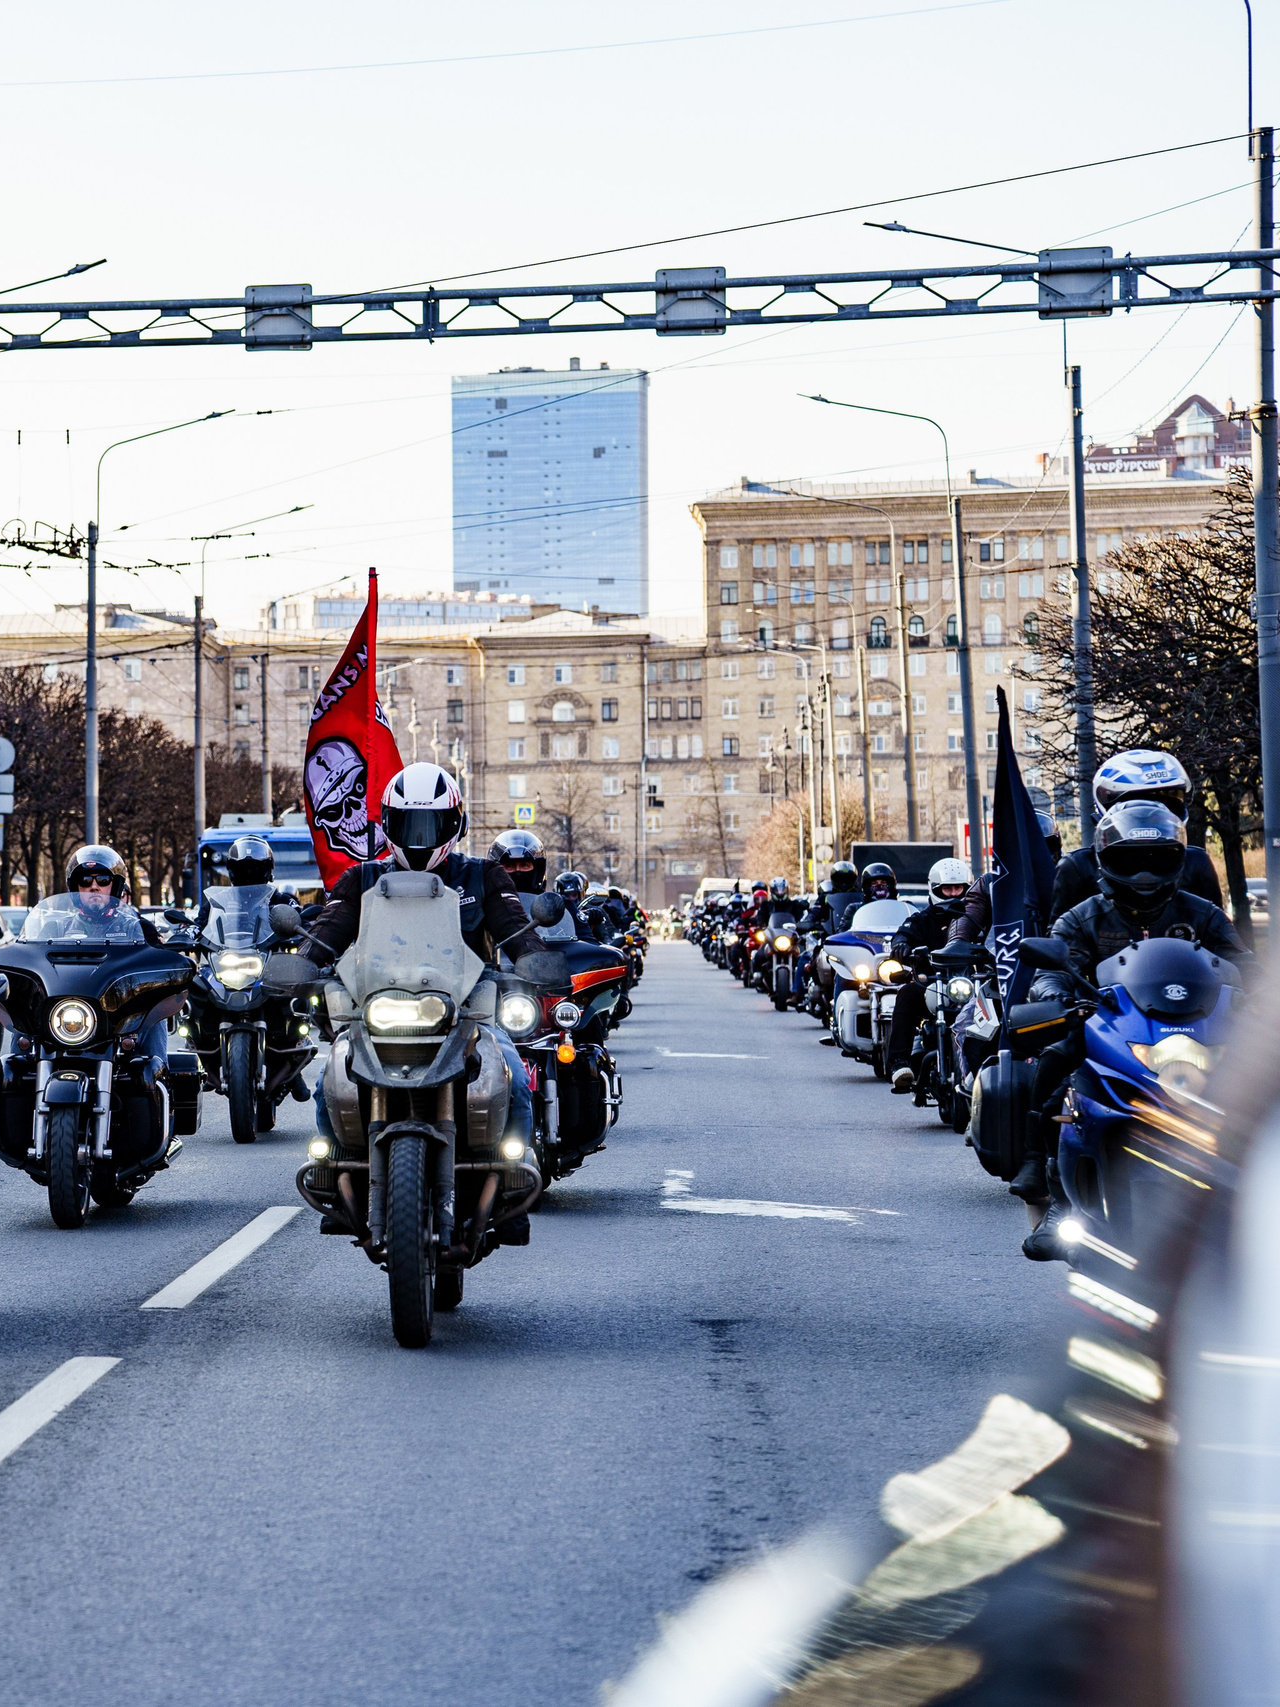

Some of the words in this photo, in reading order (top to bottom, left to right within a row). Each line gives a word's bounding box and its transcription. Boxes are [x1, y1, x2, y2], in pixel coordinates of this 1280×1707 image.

[310, 665, 358, 724] GANS
[1145, 770, 1168, 780] SHOEI
[1132, 829, 1157, 837] SHOEI
